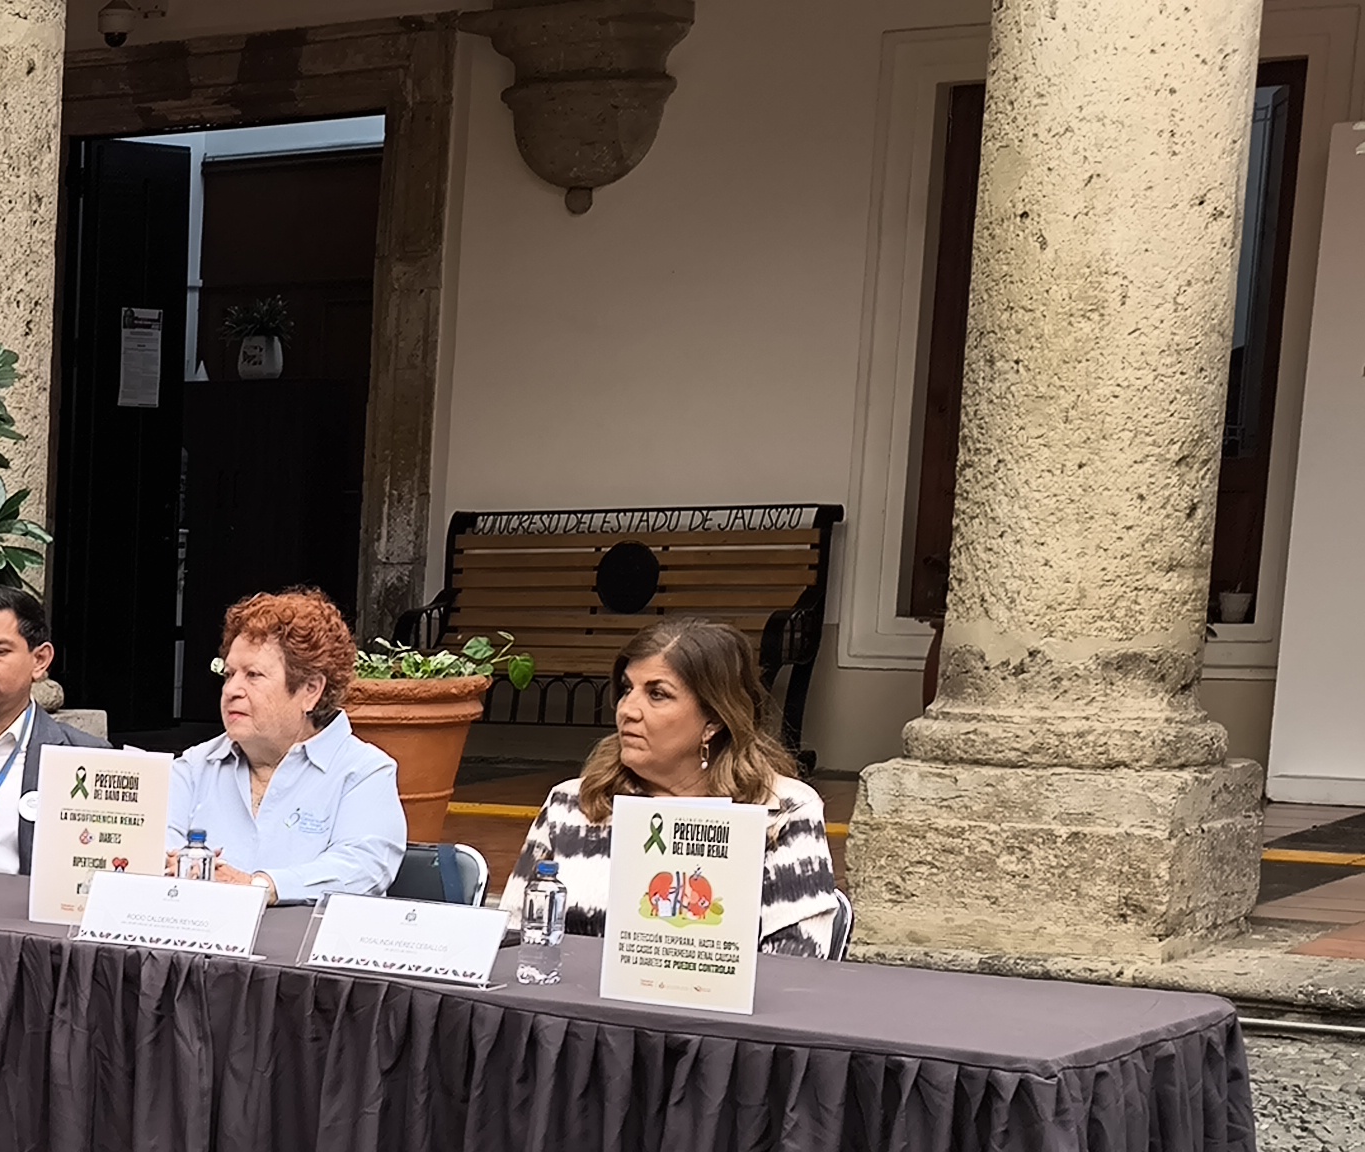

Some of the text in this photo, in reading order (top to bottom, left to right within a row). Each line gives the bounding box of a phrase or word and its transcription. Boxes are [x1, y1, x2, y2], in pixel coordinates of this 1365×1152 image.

[471, 507, 802, 535] CONGRESO DEL ESTADO DE JALISCO
[673, 841, 683, 855] DEL
[707, 844, 728, 859] RENAL
